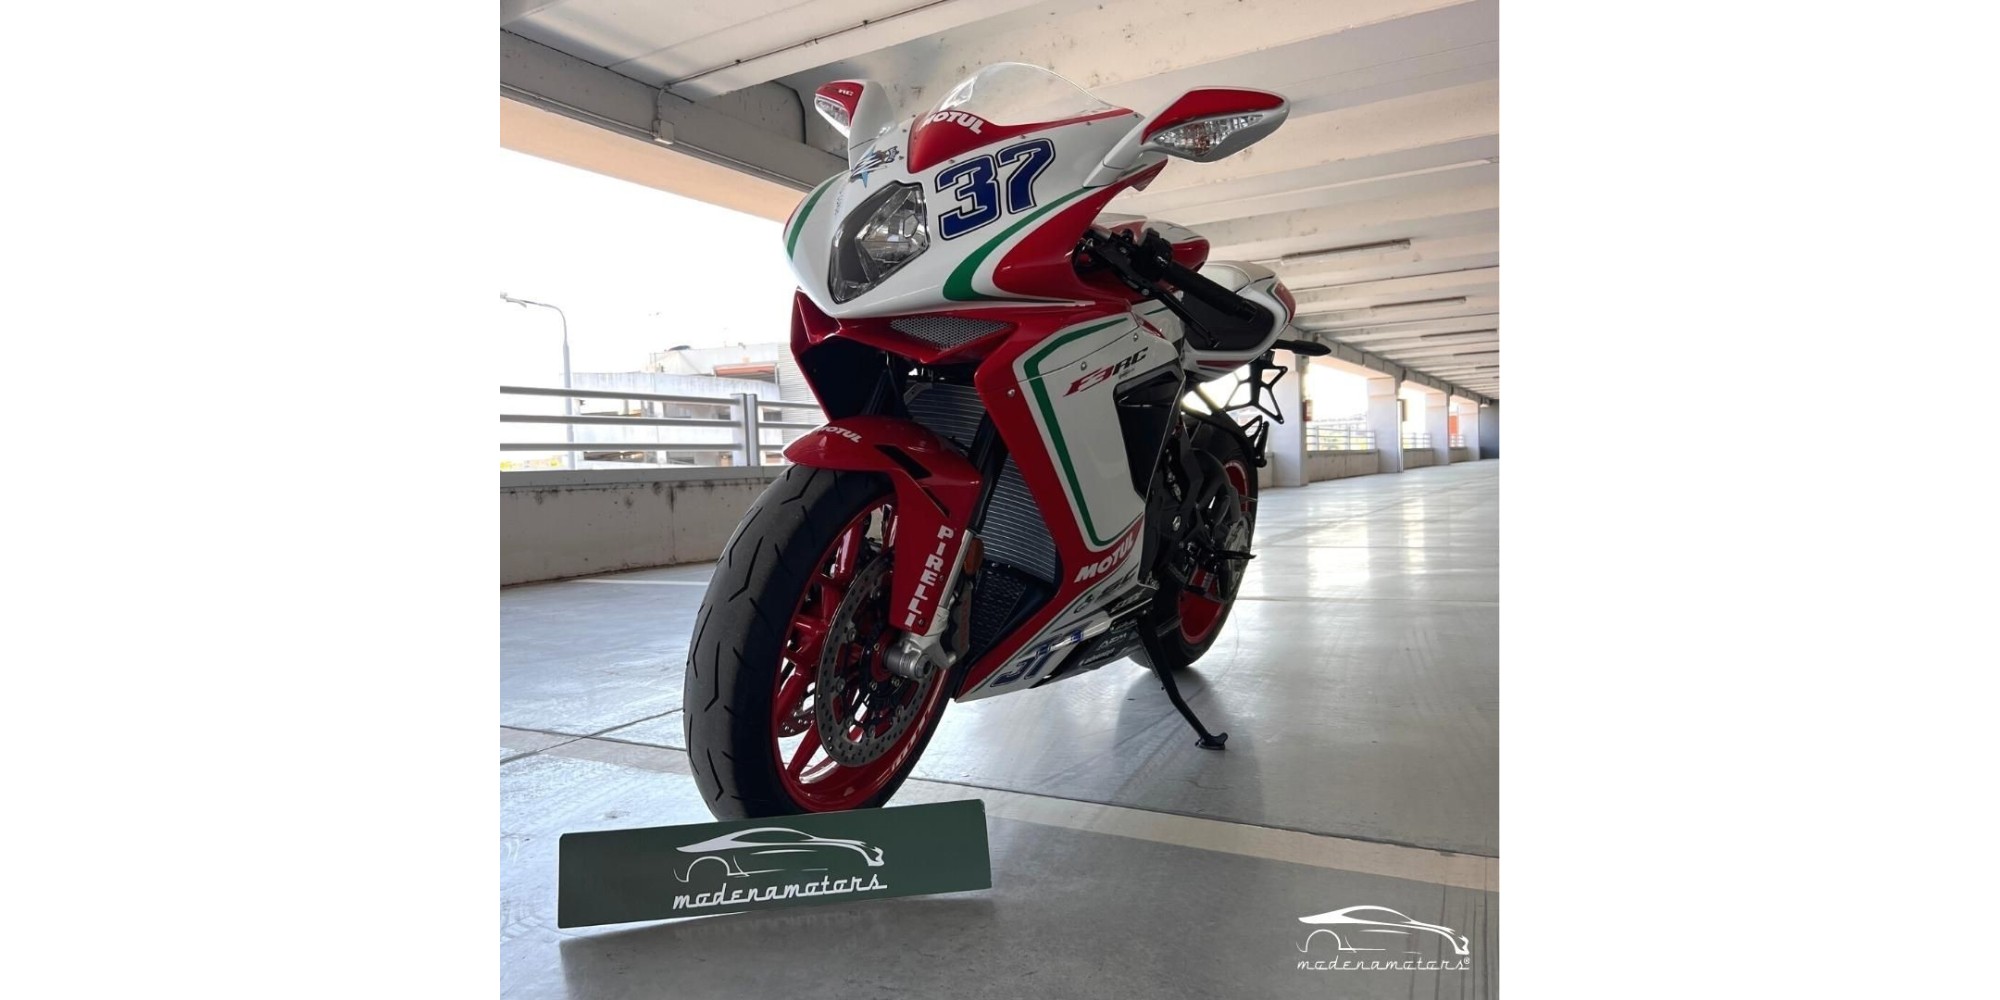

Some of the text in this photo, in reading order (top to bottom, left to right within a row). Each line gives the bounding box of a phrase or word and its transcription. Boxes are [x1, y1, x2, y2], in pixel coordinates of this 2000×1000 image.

[934, 137, 1056, 241] 37
[904, 524, 955, 628] PIRELLI
[1073, 532, 1134, 584] MOTUL
[672, 873, 888, 911] modenamotors
